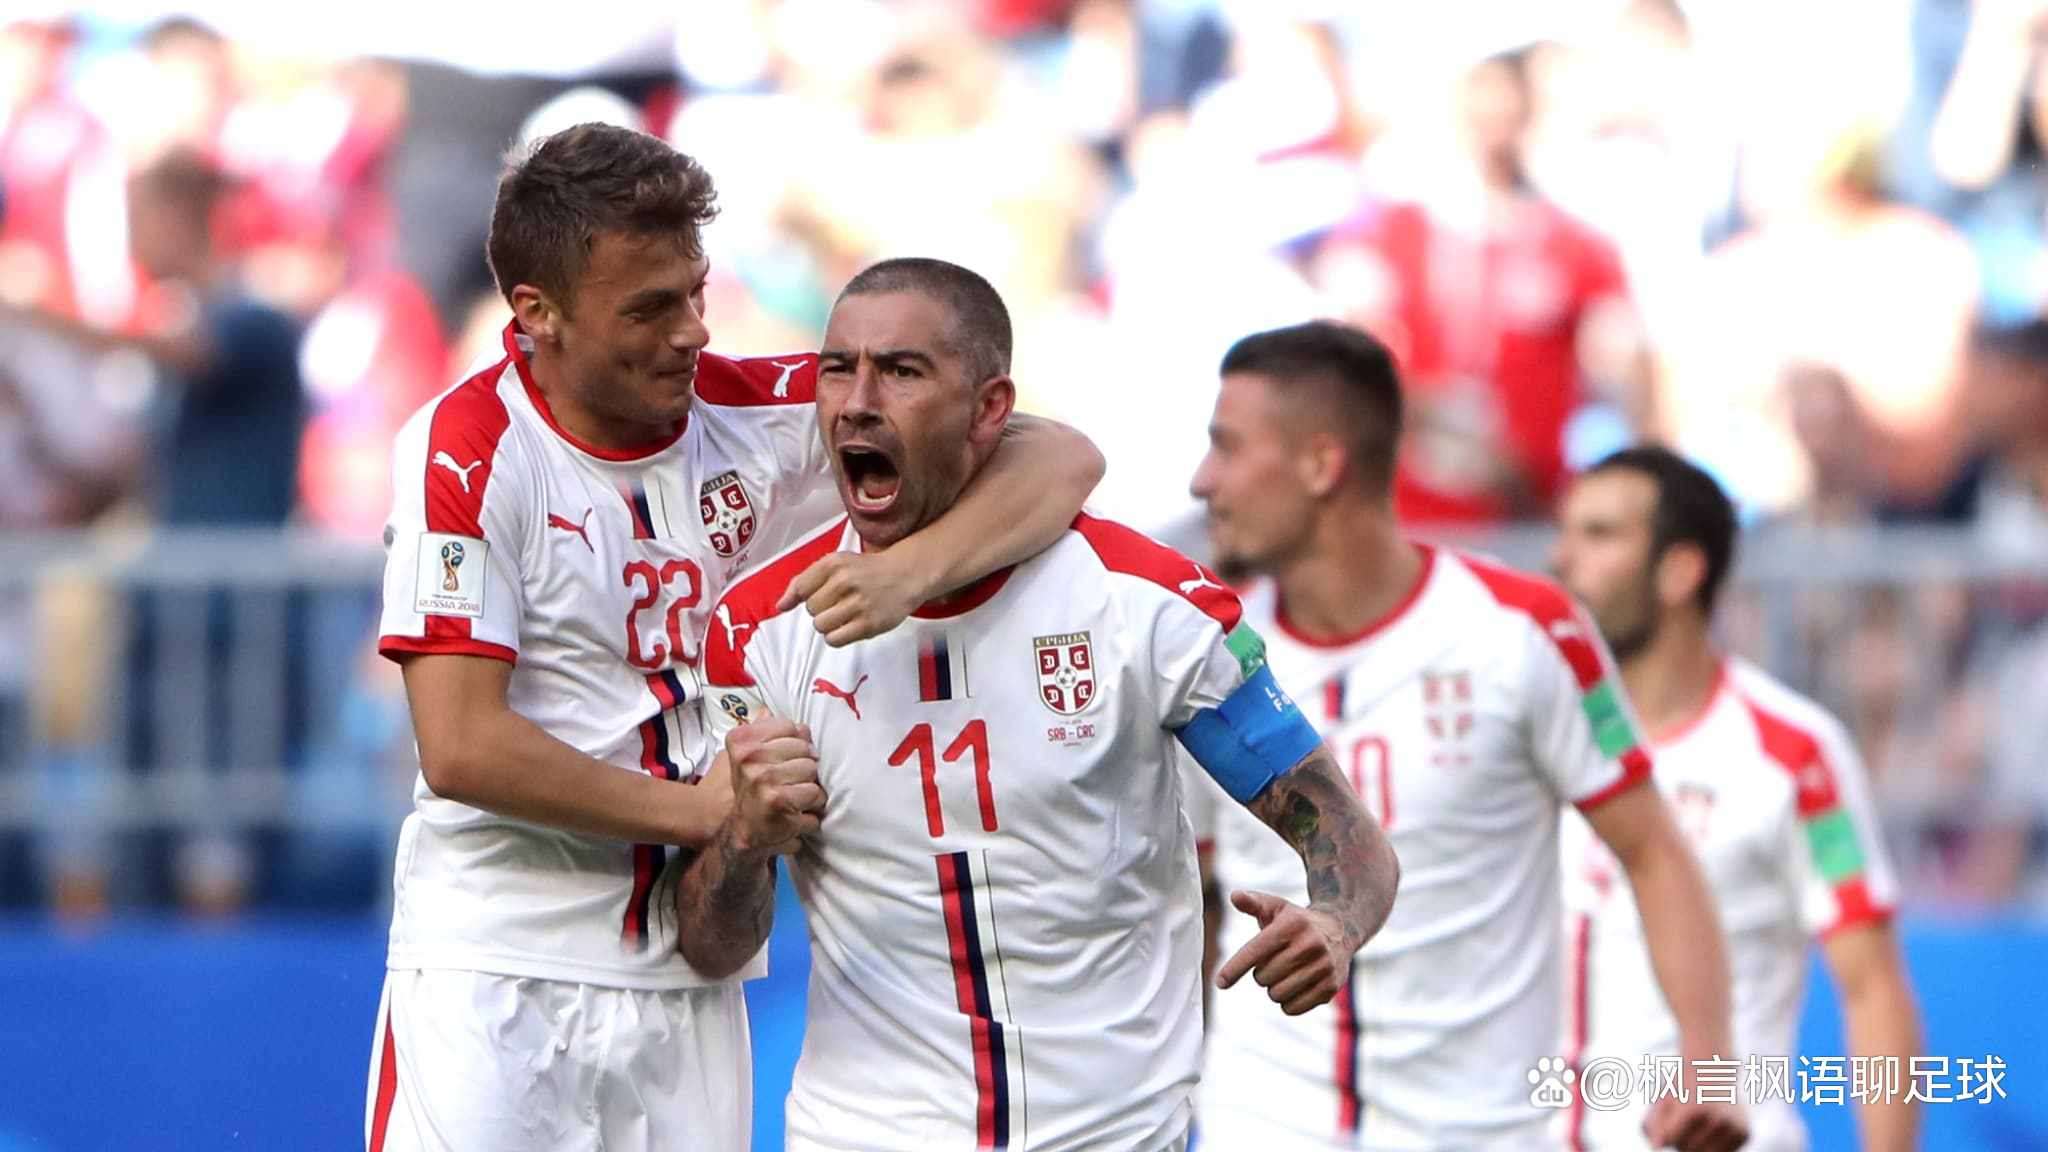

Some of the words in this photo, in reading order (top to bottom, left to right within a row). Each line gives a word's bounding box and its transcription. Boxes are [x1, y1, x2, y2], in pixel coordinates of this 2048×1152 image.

[419, 599, 456, 609] RUSSIA
[623, 558, 702, 670] 22
[1047, 726, 1066, 742] SRB
[1077, 724, 1095, 740] CRC
[887, 719, 998, 838] 11
